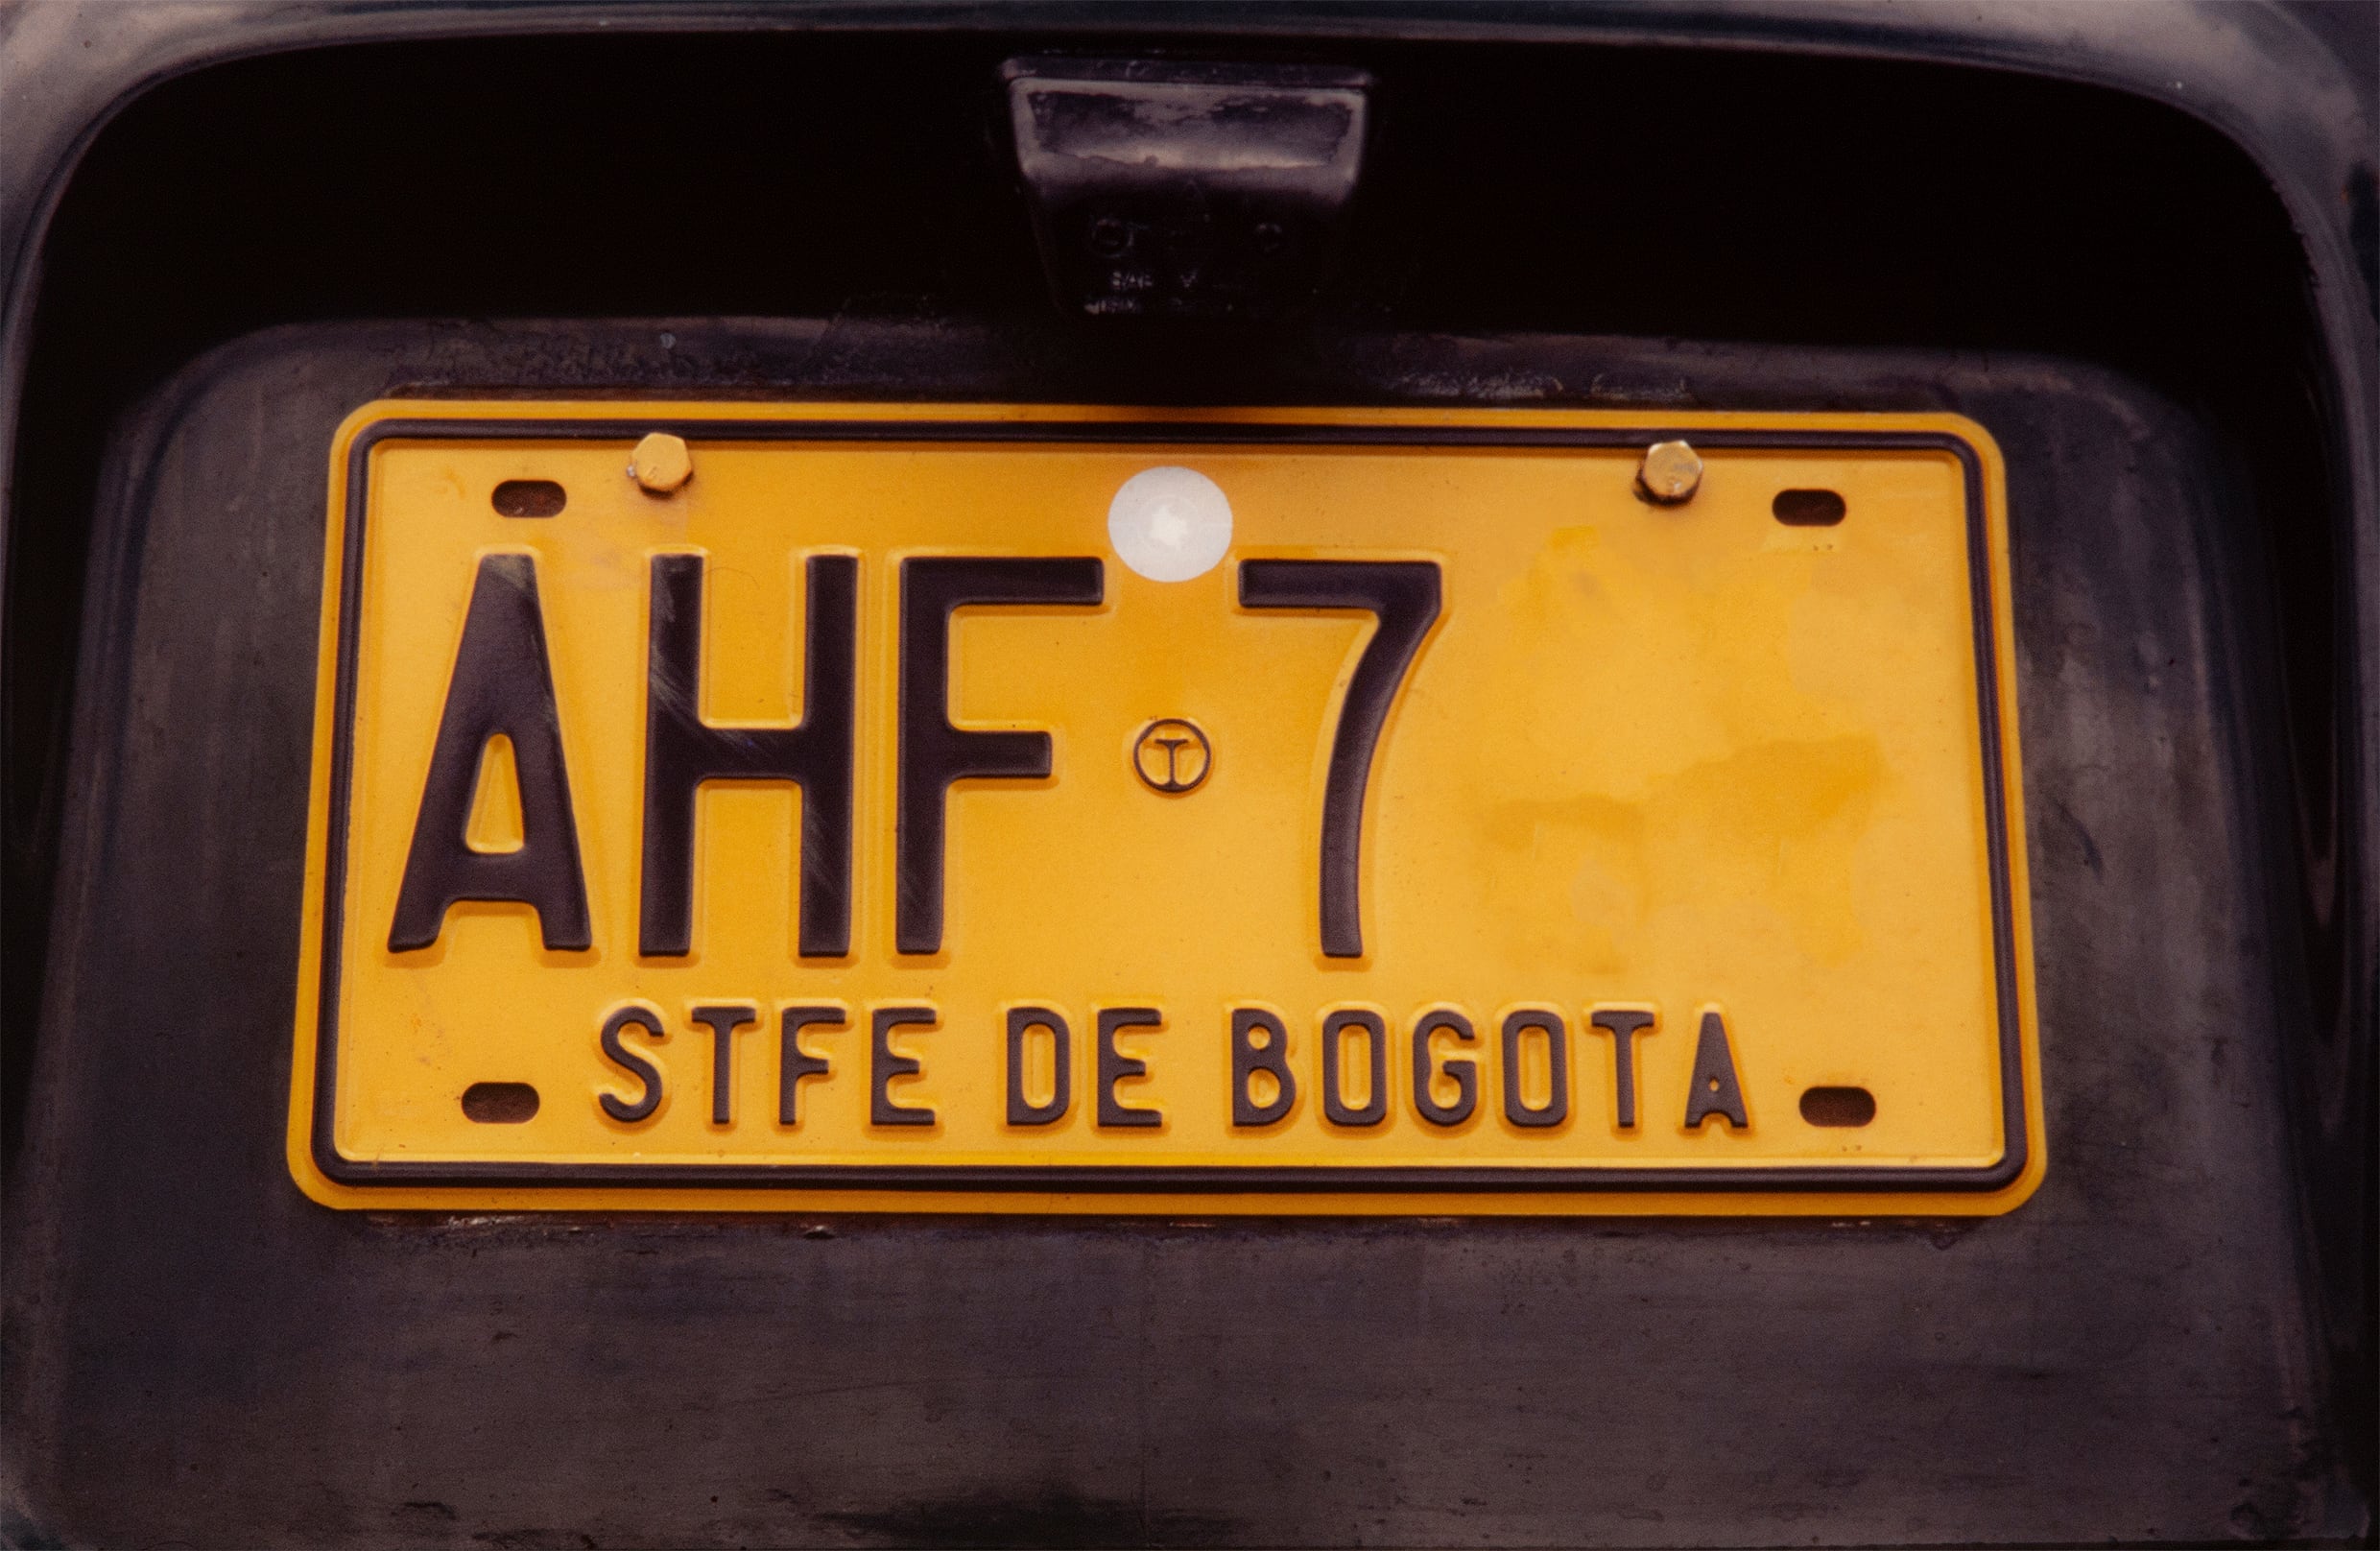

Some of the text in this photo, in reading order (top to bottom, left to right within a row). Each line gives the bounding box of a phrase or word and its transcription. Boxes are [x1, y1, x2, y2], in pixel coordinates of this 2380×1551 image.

[387, 553, 1442, 958] AHF 7
[598, 1005, 1749, 1129] STFE DE BOGOTA
